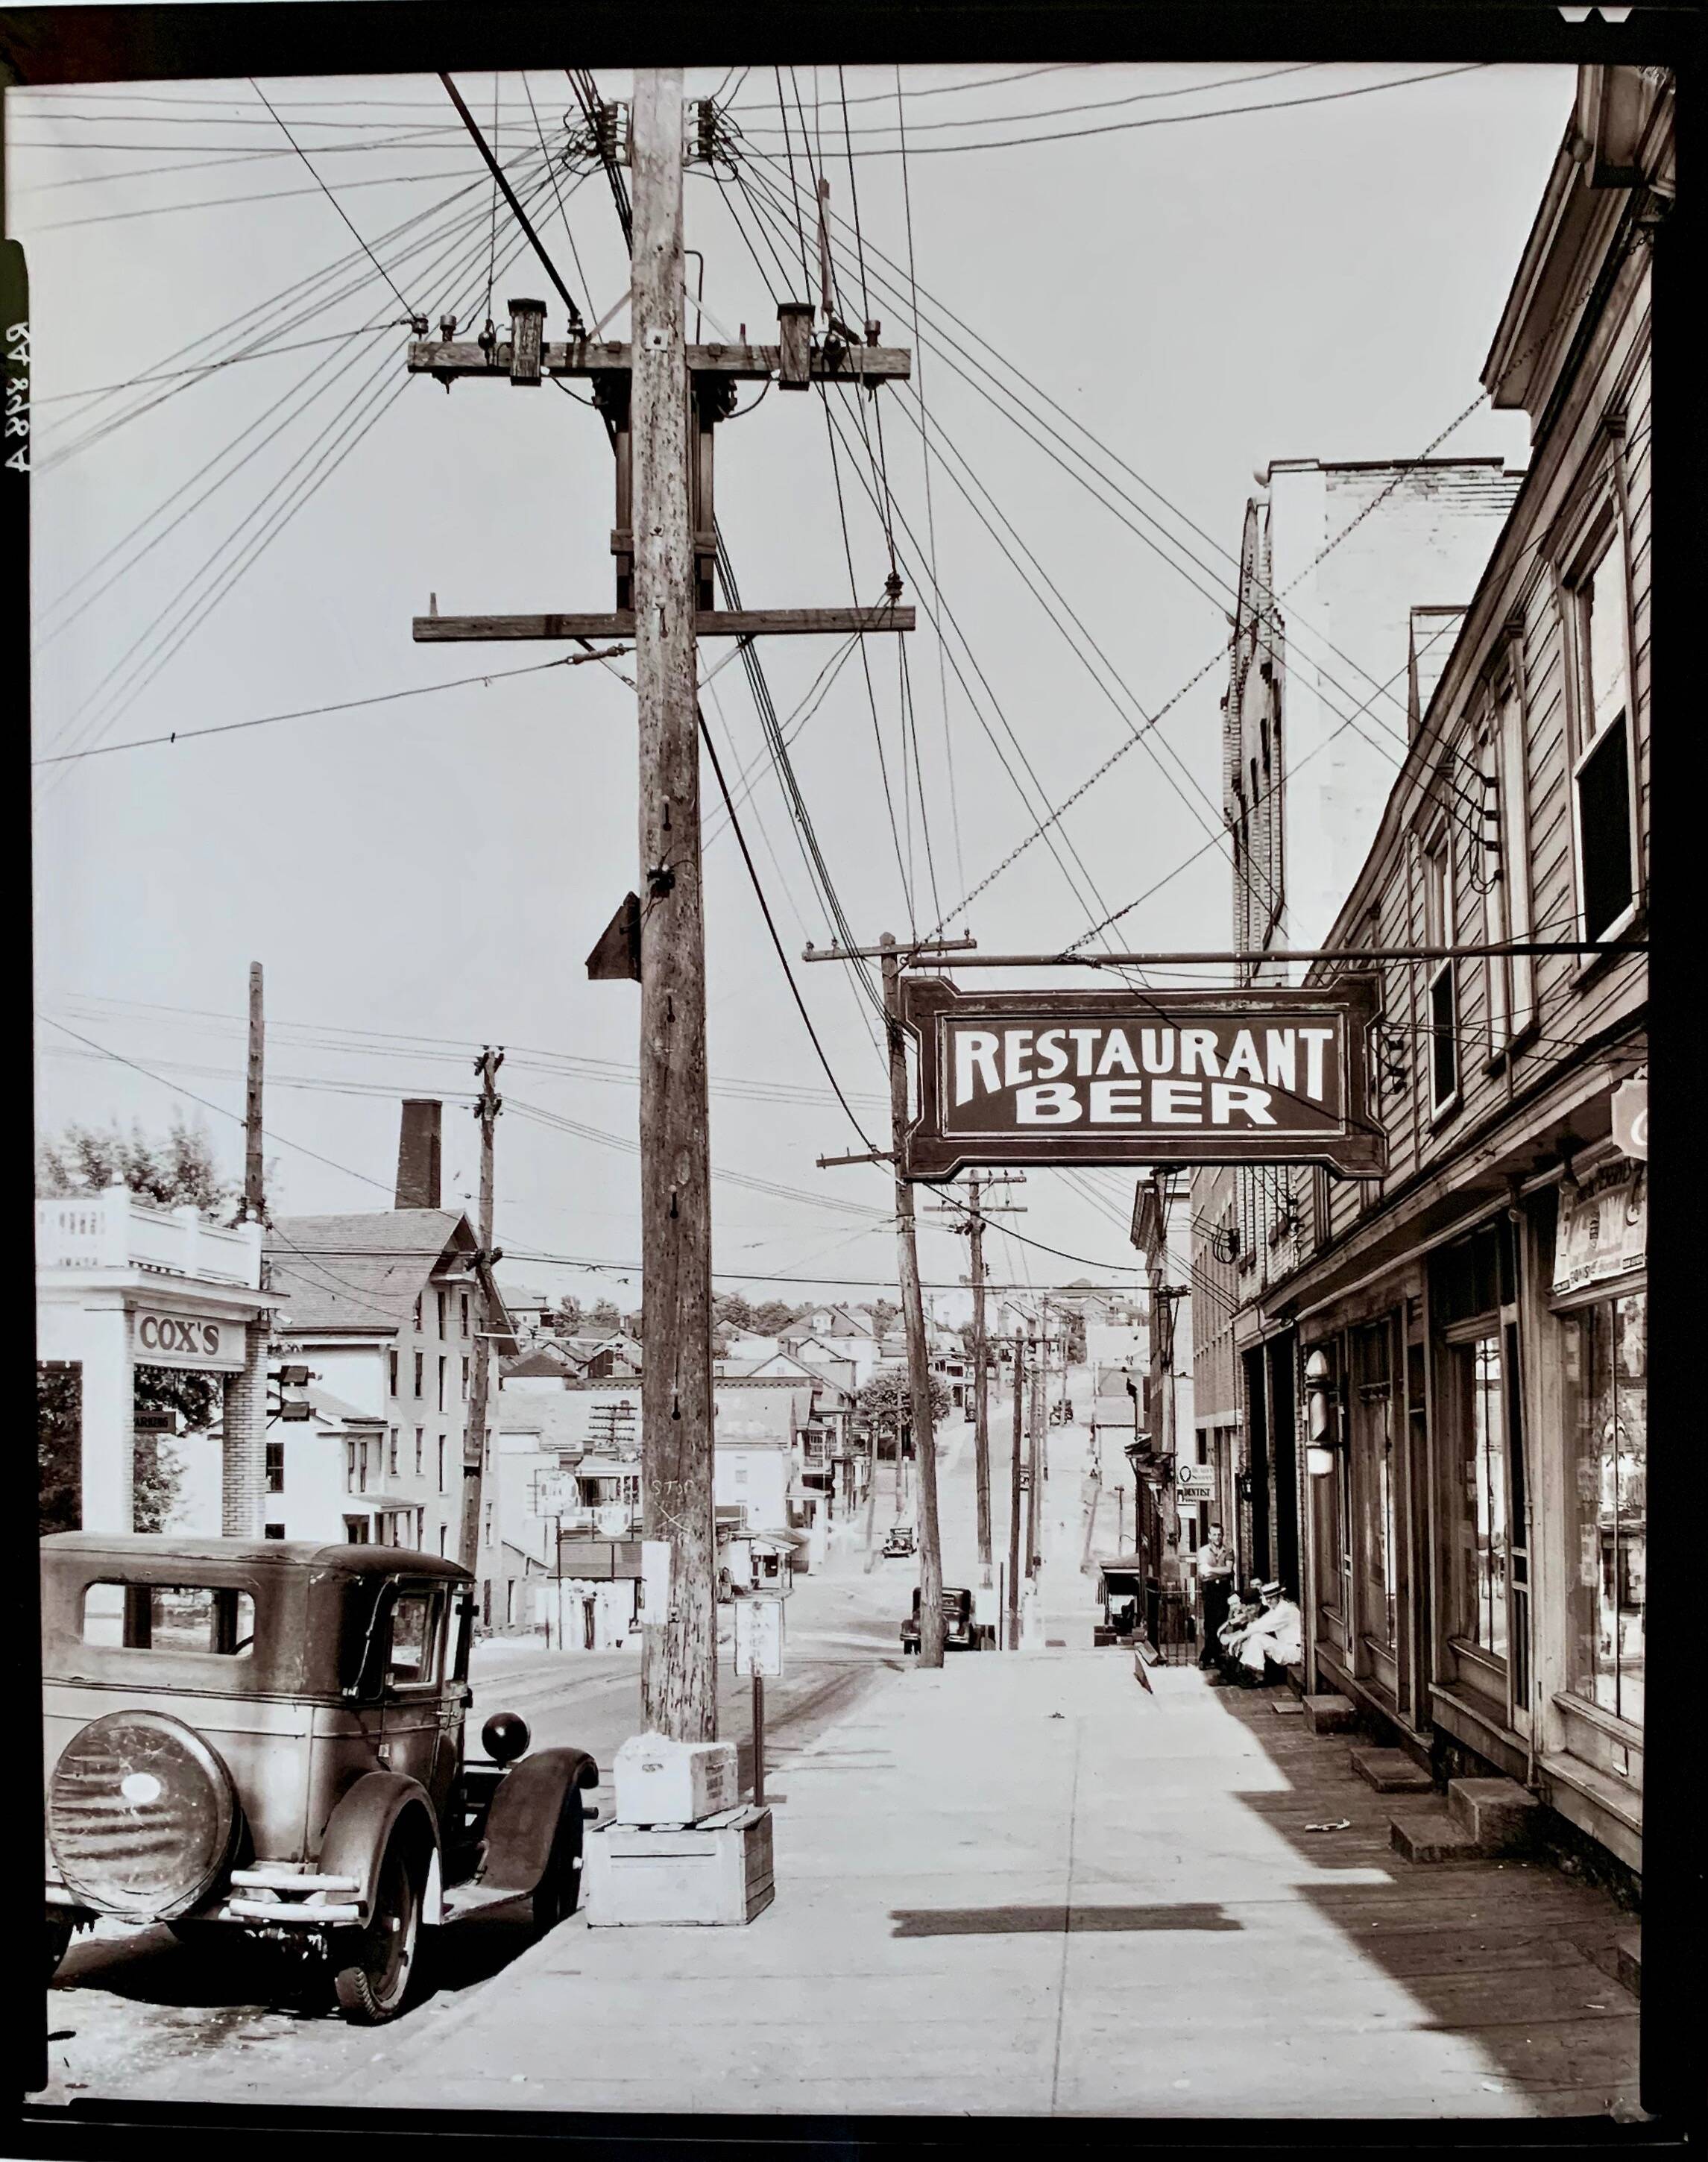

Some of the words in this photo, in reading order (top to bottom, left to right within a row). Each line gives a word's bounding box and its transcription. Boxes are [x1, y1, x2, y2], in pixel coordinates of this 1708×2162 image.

[955, 1027, 1334, 1106] RESTAURANT
[1016, 1079, 1279, 1124] BEER
[140, 1316, 219, 1355] COX'S
[133, 1416, 168, 1428] ARKING
[1184, 1488, 1211, 1497] DENTIST
